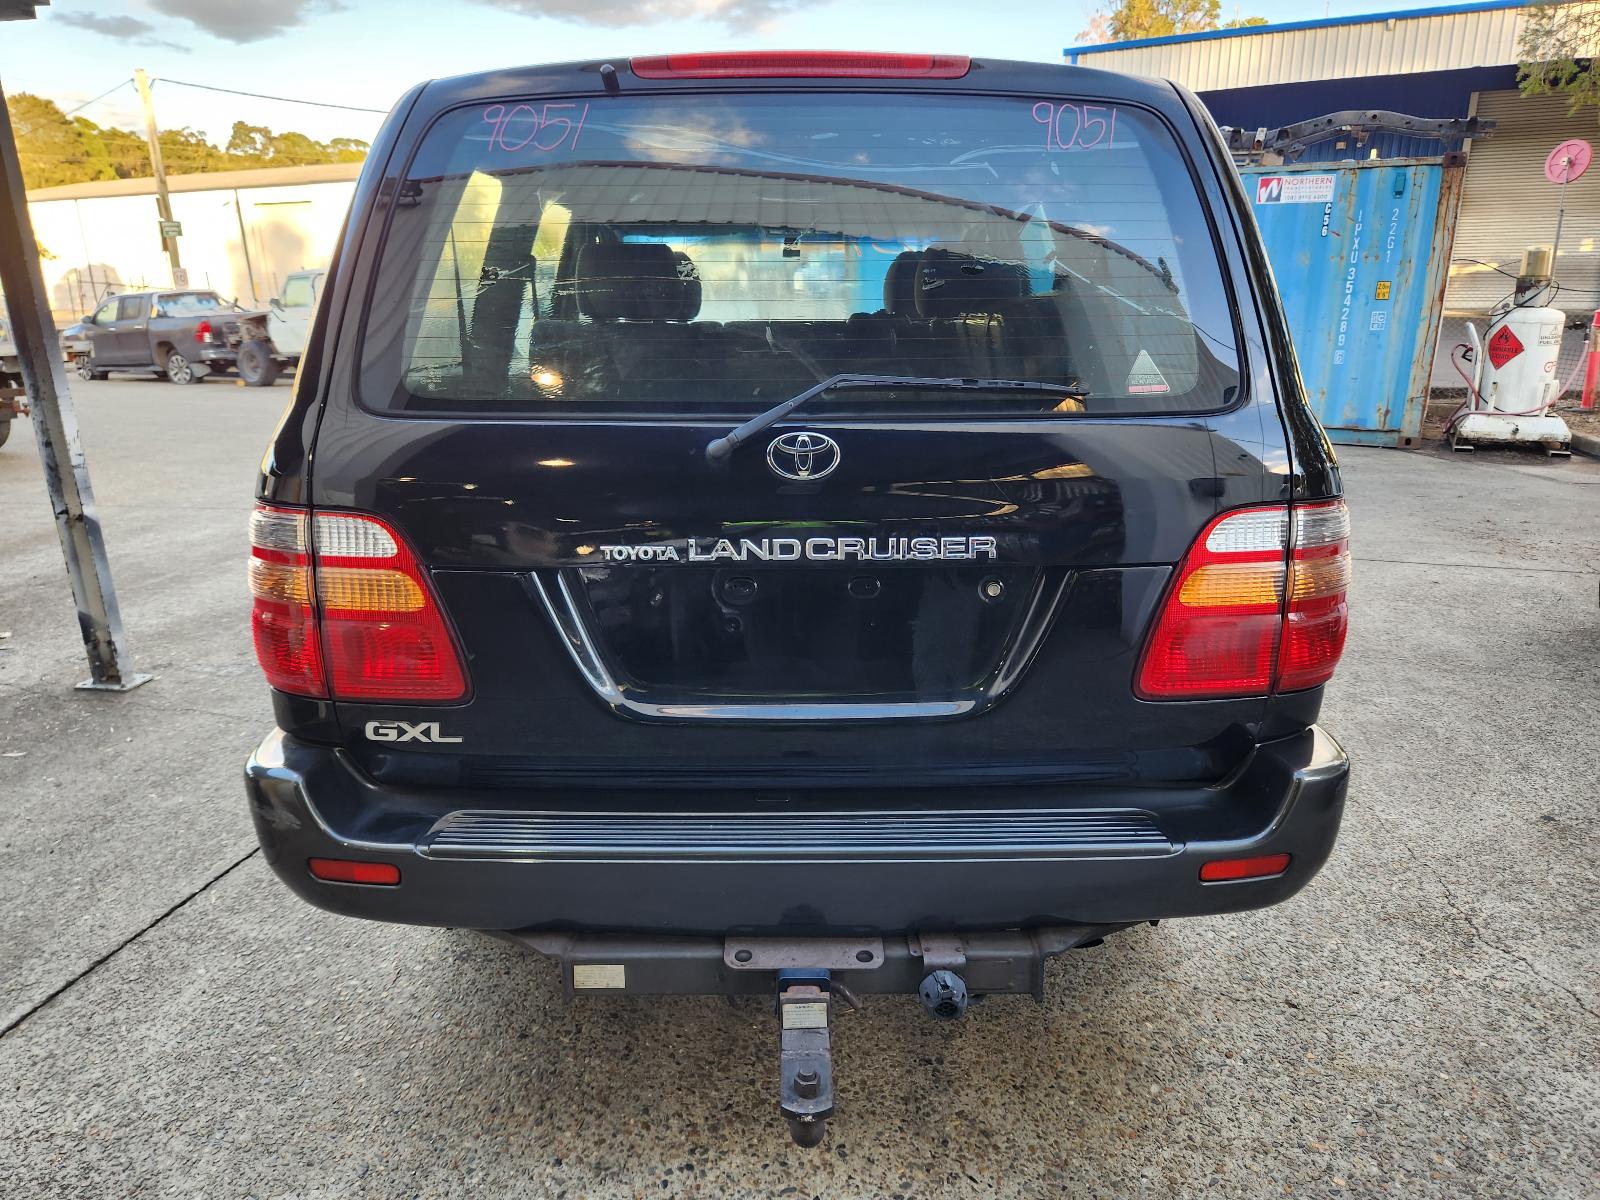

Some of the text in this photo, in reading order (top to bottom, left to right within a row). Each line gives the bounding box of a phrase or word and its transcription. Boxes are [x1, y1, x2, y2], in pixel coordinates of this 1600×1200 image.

[484, 103, 589, 152] 9051
[1032, 102, 1117, 152] 9051
[600, 545, 680, 561] TOYOTA
[365, 721, 463, 743] GXL
